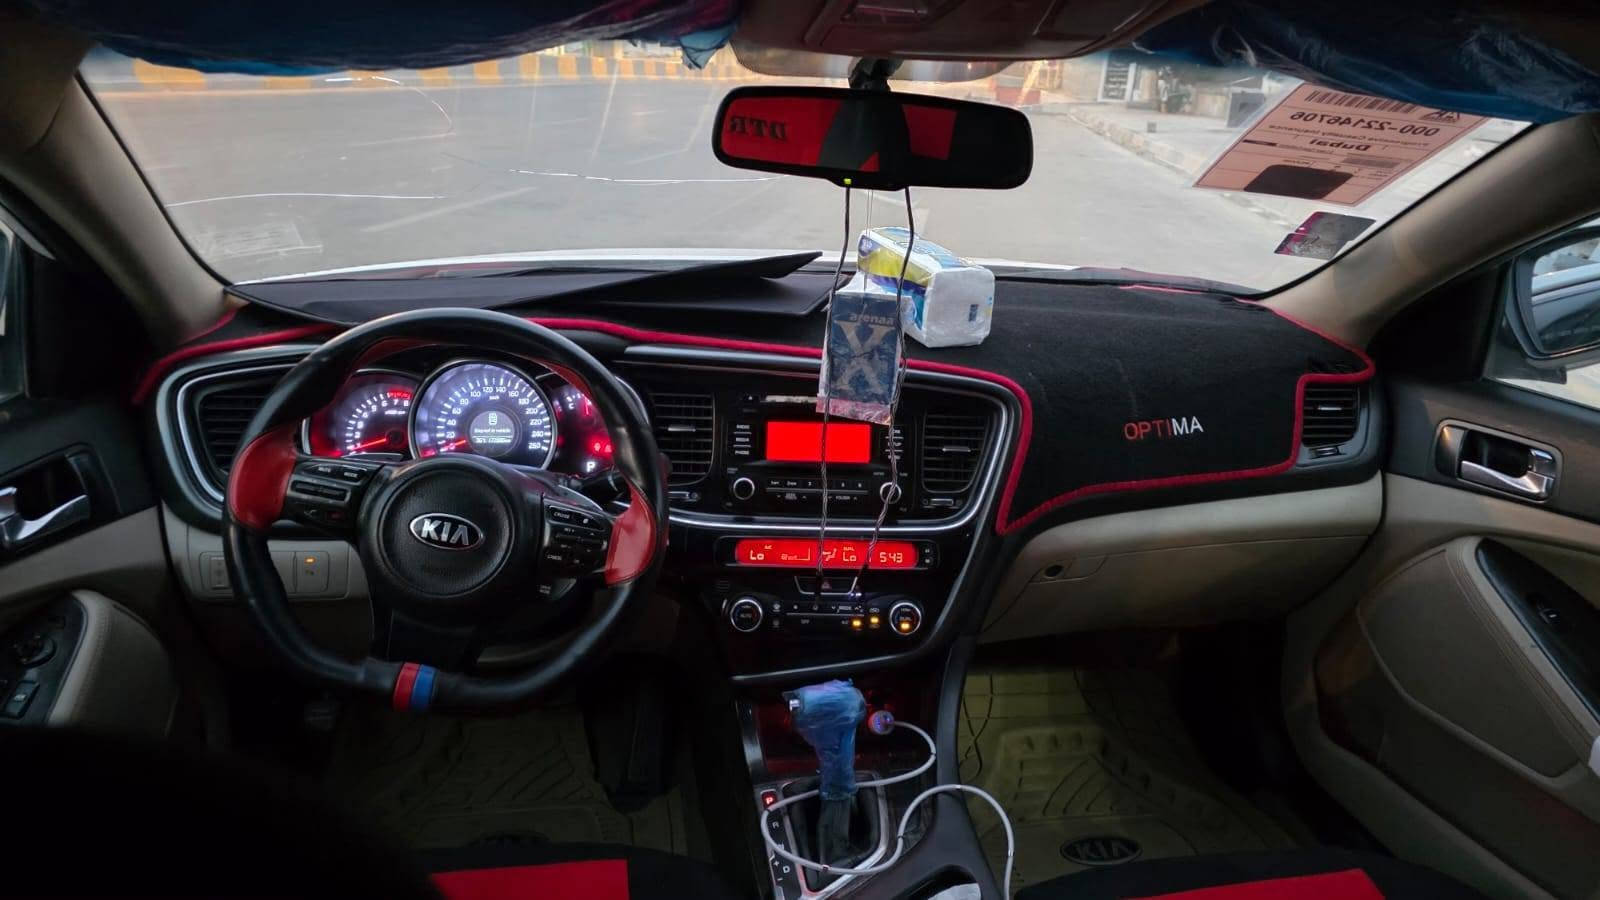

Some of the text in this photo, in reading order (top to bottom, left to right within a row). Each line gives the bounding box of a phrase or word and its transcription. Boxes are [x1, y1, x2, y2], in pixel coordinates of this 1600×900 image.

[525, 407, 538, 415] 200
[446, 418, 457, 426] 40
[529, 418, 543, 426] 220
[1123, 415, 1204, 440] OPTIMA
[446, 431, 456, 439] 20
[586, 461, 596, 472] P
[421, 518, 469, 546] KIA
[750, 550, 765, 561] Lo
[842, 551, 857, 562] Lo
[772, 821, 780, 829] R
[783, 865, 791, 874] D
